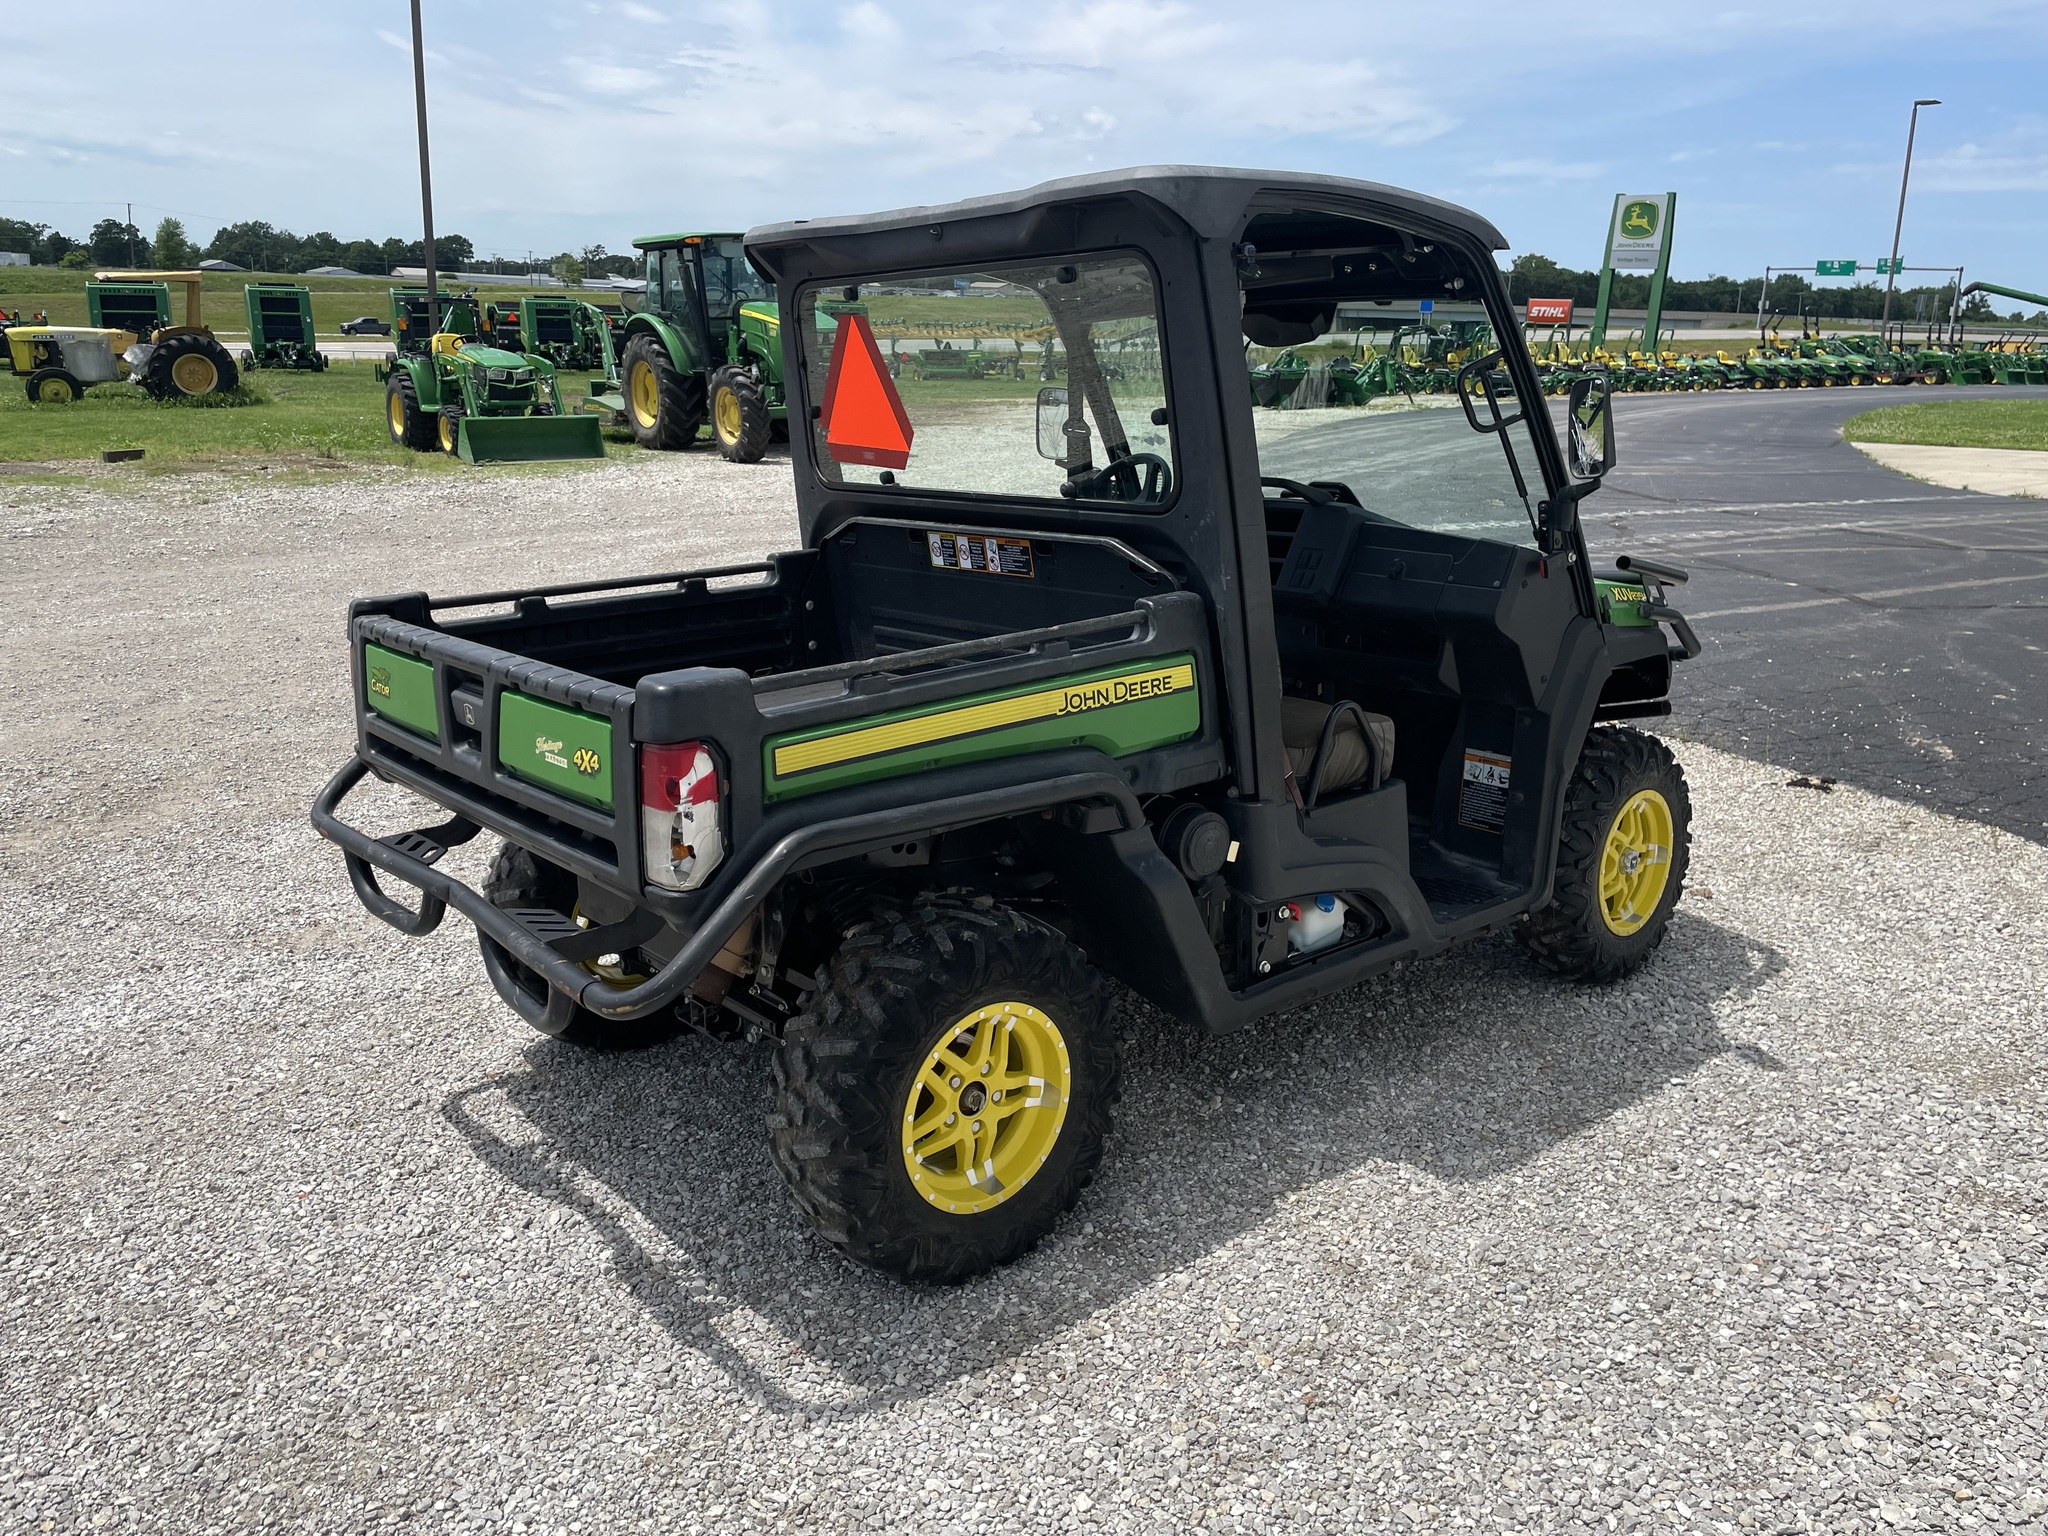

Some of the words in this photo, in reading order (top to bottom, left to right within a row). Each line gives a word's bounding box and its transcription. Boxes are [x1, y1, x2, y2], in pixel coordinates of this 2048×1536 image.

[1530, 306, 1565, 317] STIHL
[1058, 687, 1110, 713] JOHN
[1113, 675, 1173, 701] DEERE
